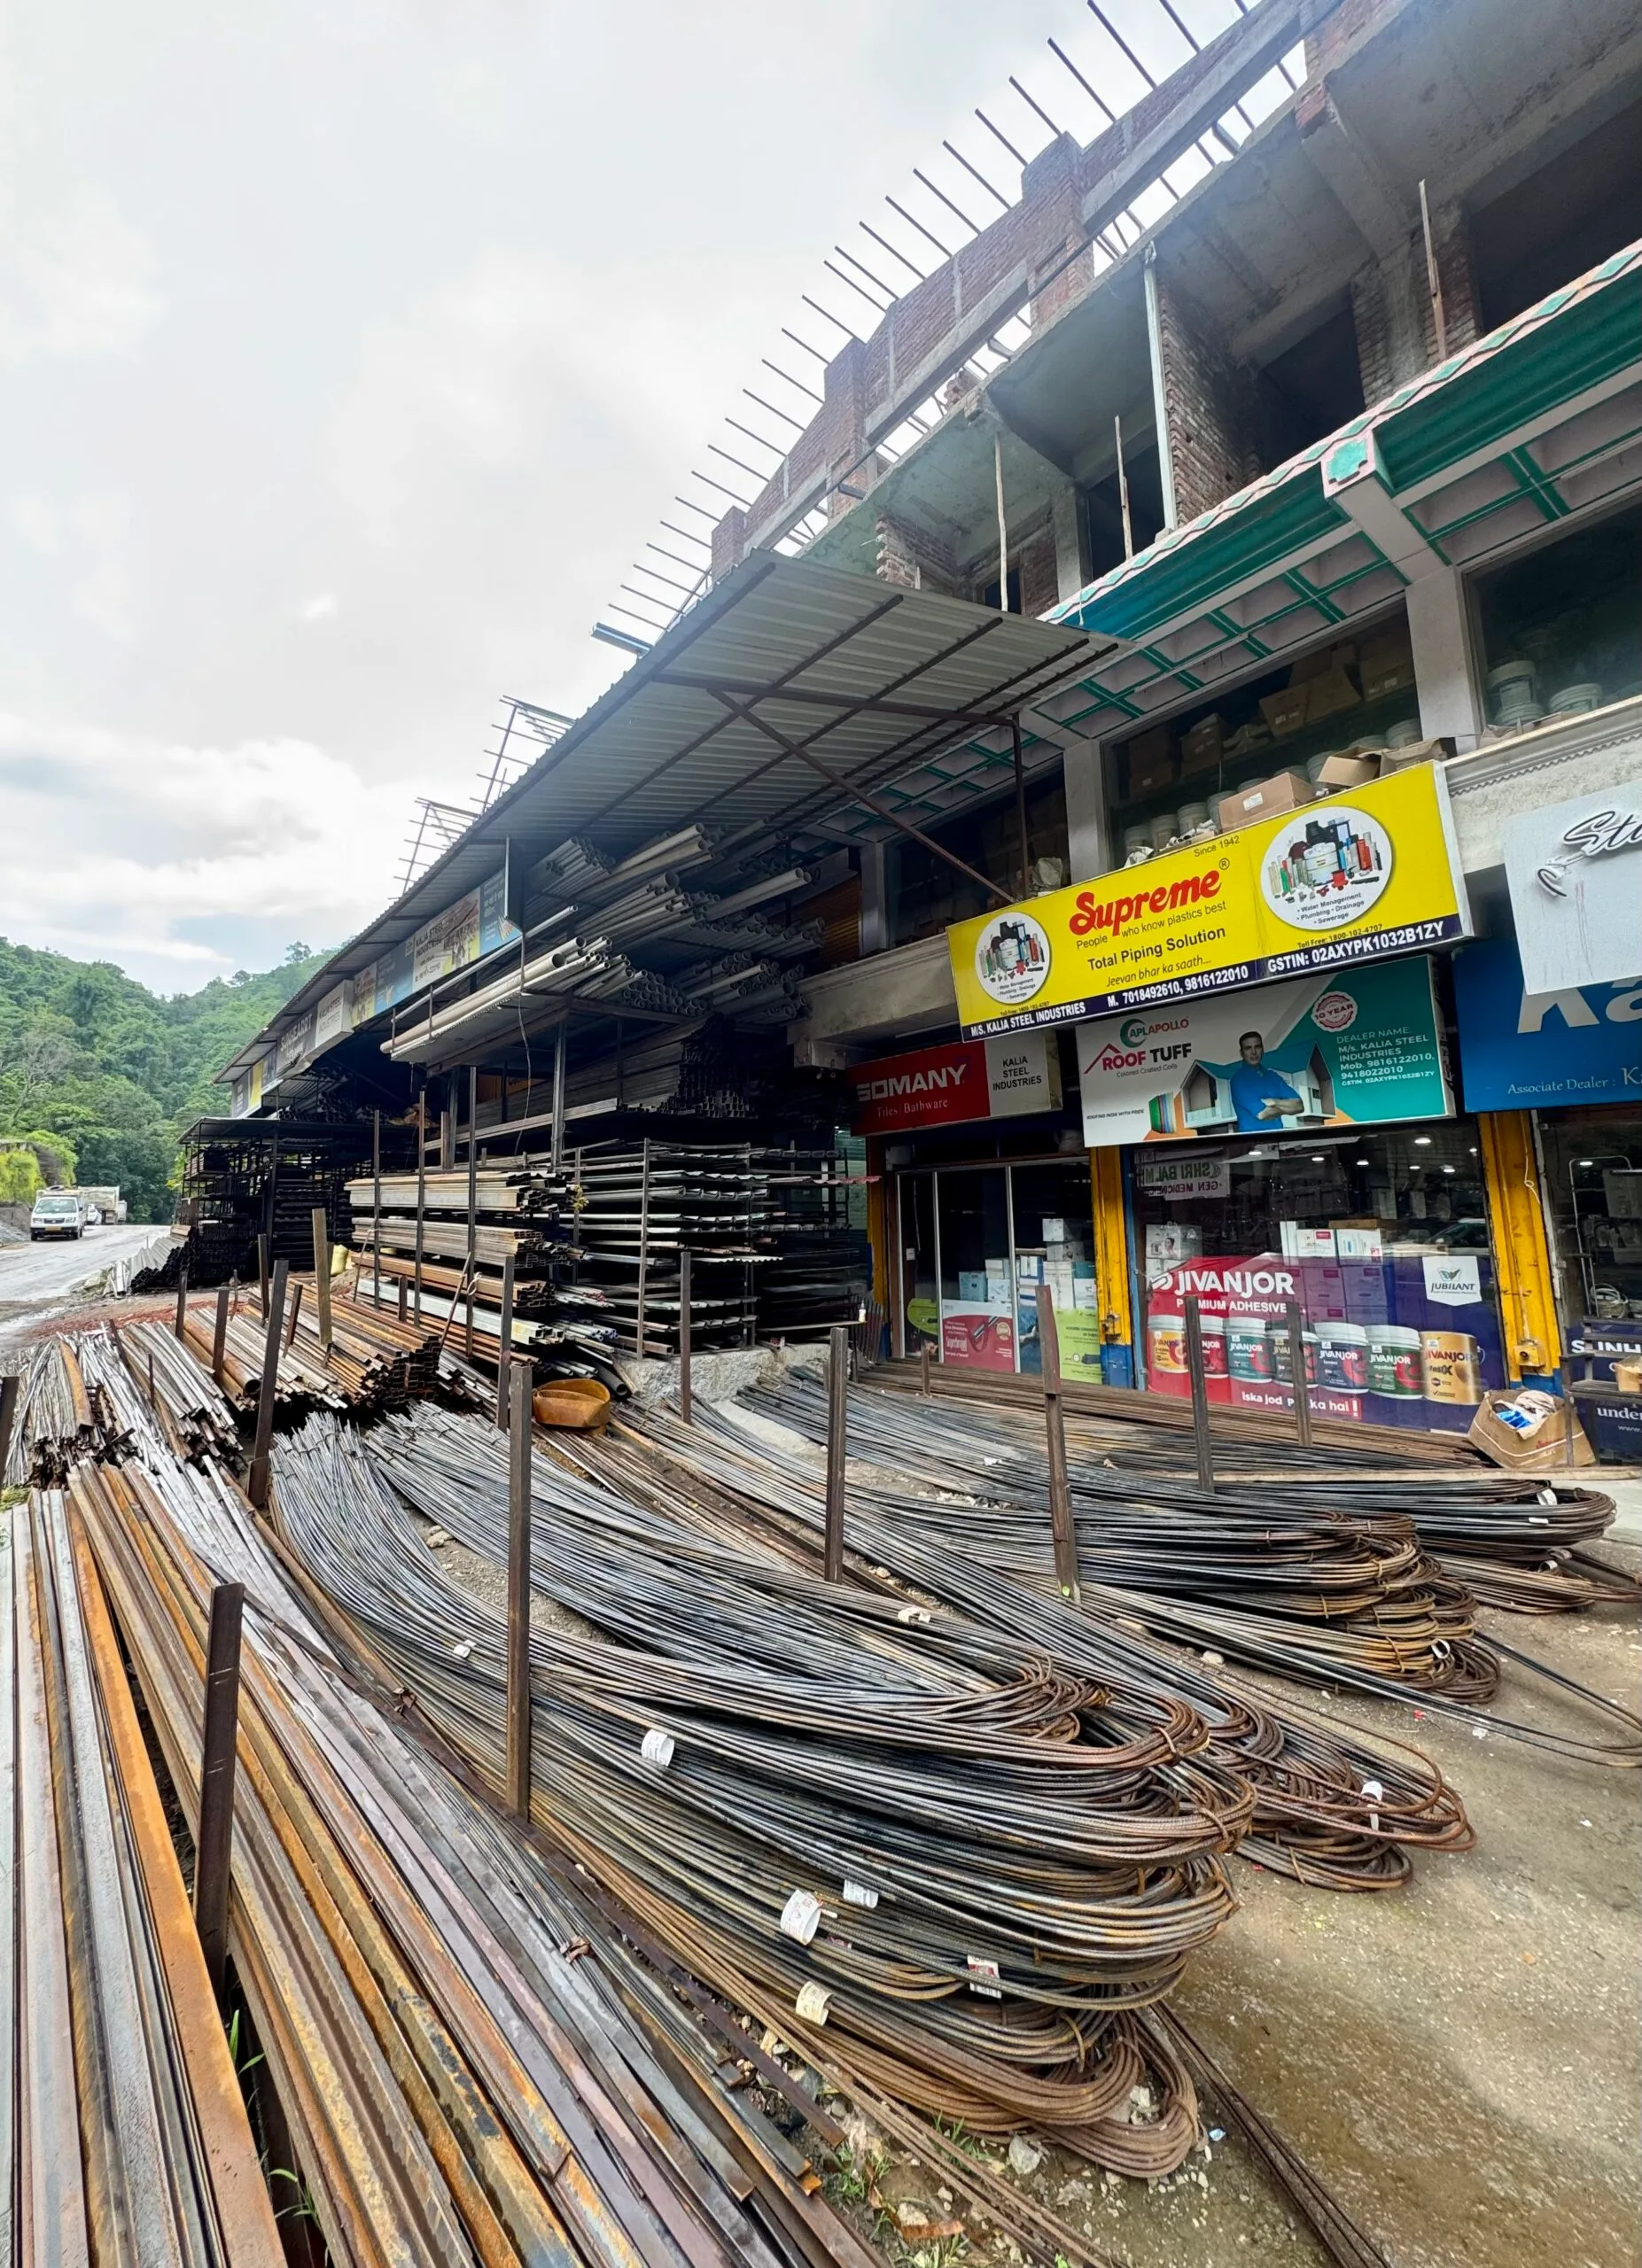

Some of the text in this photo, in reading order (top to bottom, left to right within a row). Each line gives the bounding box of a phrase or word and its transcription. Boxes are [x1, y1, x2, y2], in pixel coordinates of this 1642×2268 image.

[1194, 835, 1241, 858] Since 1942
[1070, 870, 1223, 937] Supreme
[1300, 900, 1365, 920] Plumbing Drainage
[1301, 892, 1361, 913] Water Management
[1077, 901, 1226, 950] People who know plastics best
[1318, 913, 1349, 924] Sewerage
[1087, 927, 1226, 971] Total Piping Solution
[1267, 920, 1444, 973] GSTIN: 02AXYPK1032B1ZY
[1106, 974, 1137, 988] Jeevan
[1139, 966, 1160, 980] bhar
[1162, 963, 1173, 973] ka
[970, 966, 1249, 1037] M/S. KALIA STEEL INDUSTRIES M. 7018492610, 9816122010
[1314, 1003, 1354, 1021] 10 YEAR
[1336, 1031, 1375, 1044] DEALER
[1338, 1034, 1429, 1053] M/s. KALIA STEEL
[1002, 1055, 1028, 1068] KALIA
[1101, 1043, 1192, 1071] ROOF TUFF
[1339, 1047, 1402, 1062] INDUSTRIES
[1002, 1067, 1030, 1078] STEEL
[1116, 1069, 1139, 1078] Colored
[1140, 1066, 1161, 1075] Coated
[1340, 1062, 1365, 1071] Mob.
[1341, 1066, 1404, 1079] 9418022010
[856, 1063, 967, 1102] SOMANY
[992, 1075, 1042, 1091] INDUSTRIES
[1507, 1081, 1563, 1095] Associate
[1566, 1076, 1609, 1090] Dealer
[876, 1098, 949, 1118] Tiles Bathware
[1174, 1270, 1295, 1299] JIVANJOR
[1431, 1282, 1475, 1293] JUBILANT
[1176, 1298, 1226, 1310] PMIUM
[1229, 1343, 1264, 1353] JIVANJOR
[1319, 1350, 1358, 1361] JIVANJOR
[1369, 1355, 1412, 1365] JIVANJOR
[1264, 1393, 1282, 1406] jod
[1287, 1397, 1326, 1410] pka
[1329, 1399, 1349, 1412] hai
